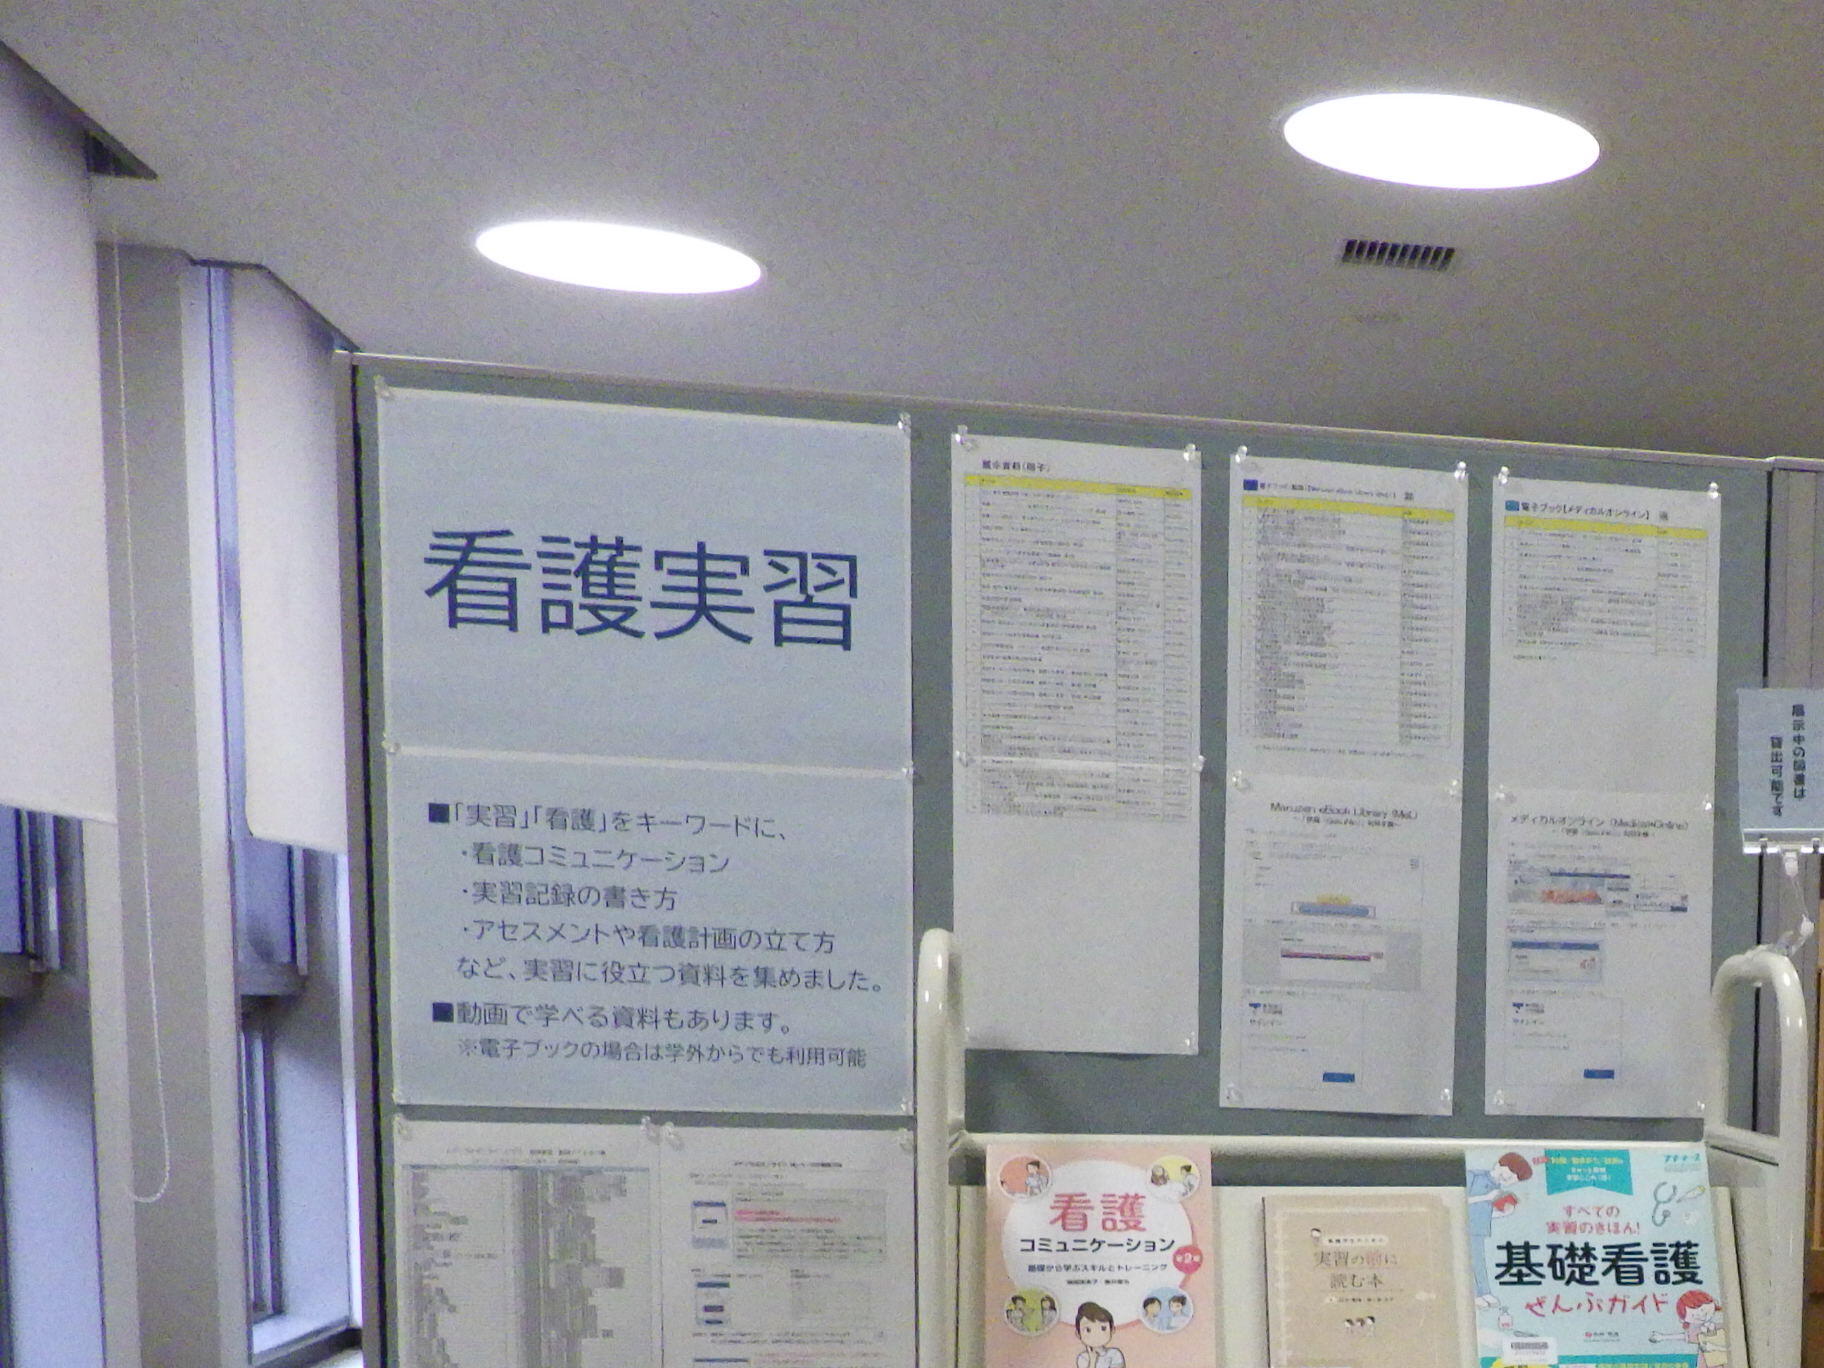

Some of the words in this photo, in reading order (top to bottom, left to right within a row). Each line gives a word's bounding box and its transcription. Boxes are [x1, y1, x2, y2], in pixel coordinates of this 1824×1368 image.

[424, 530, 859, 650] 看護実習
[1770, 736, 1784, 817] 貸出可能です
[452, 804, 787, 842] 「実習」「看護」をキーワードに、
[456, 956, 884, 992] など、実習に役立つ資料を集めました。
[456, 1002, 796, 1035] 動画で学べる資料もあります。
[458, 1038, 866, 1068] ※電子ブックの場合は学外からでも利用可能
[1050, 1192, 1147, 1233] 看護
[1563, 1205, 1620, 1218] すべての
[1020, 1237, 1175, 1253] コミュニケーション
[1495, 1240, 1703, 1287] 基礎看護
[1524, 1292, 1669, 1317] ぜんぶガイド
